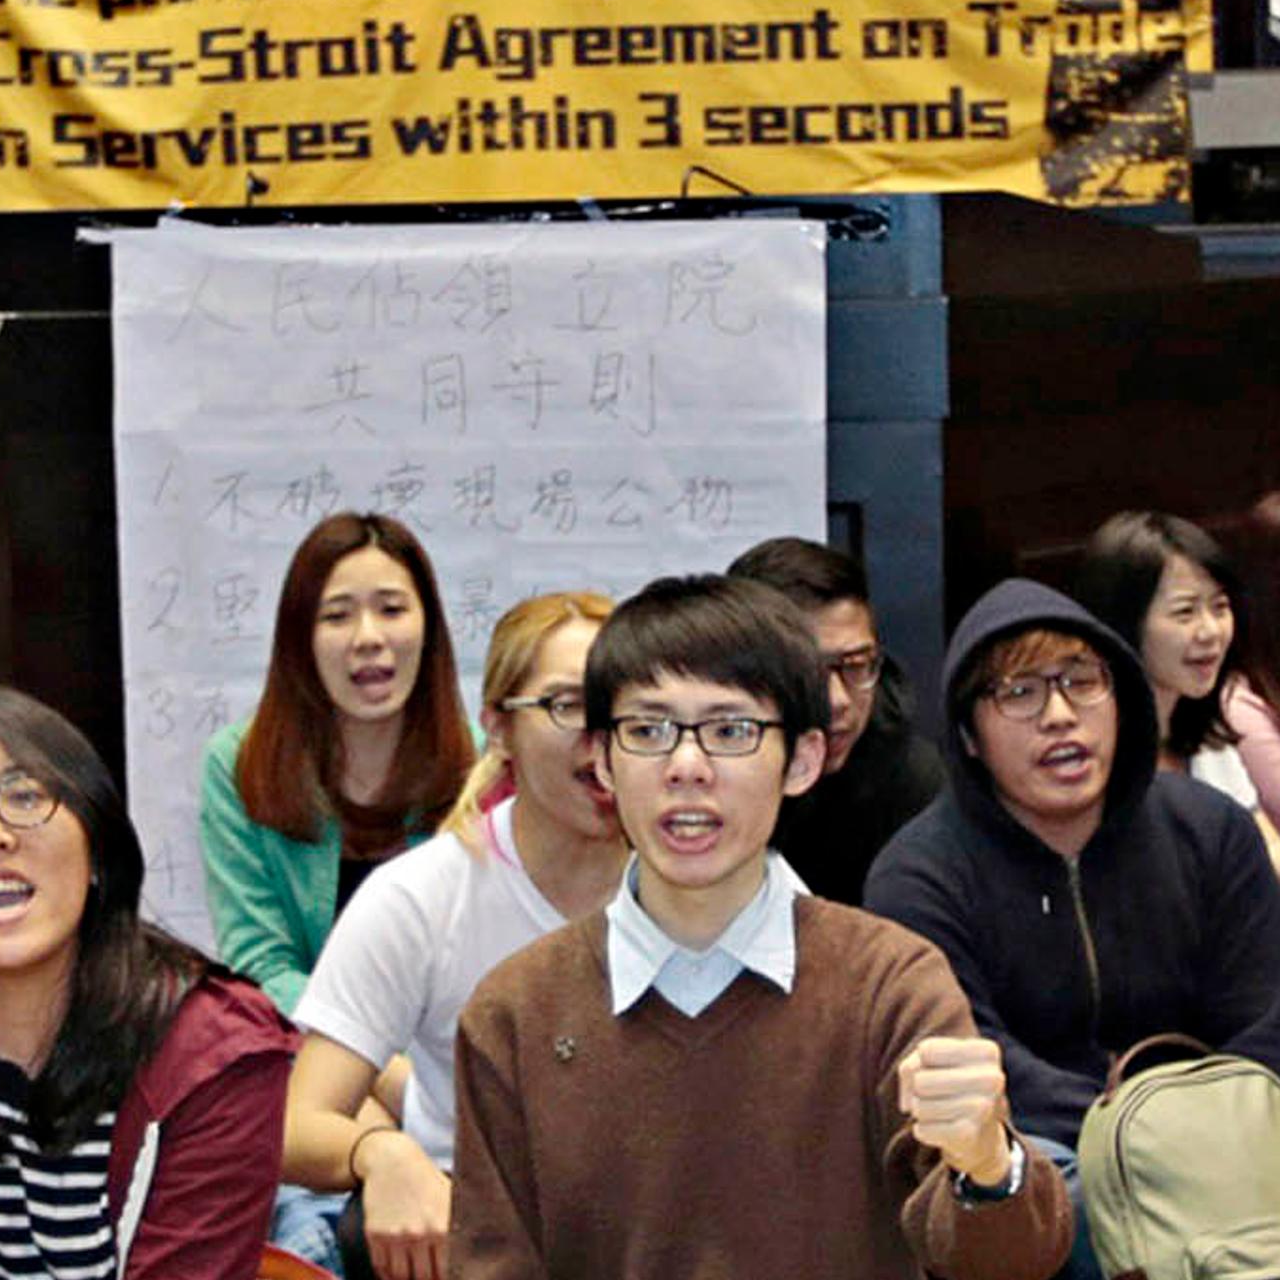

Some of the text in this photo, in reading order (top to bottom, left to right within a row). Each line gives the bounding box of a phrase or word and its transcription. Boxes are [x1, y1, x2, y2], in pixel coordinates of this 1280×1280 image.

[438, 8, 841, 83] Agreement
[861, 15, 949, 61] on
[52, 111, 372, 169] Services
[390, 94, 615, 155] within
[637, 92, 685, 149] 3
[703, 87, 1010, 144] seconds
[305, 350, 662, 439] 共同守則
